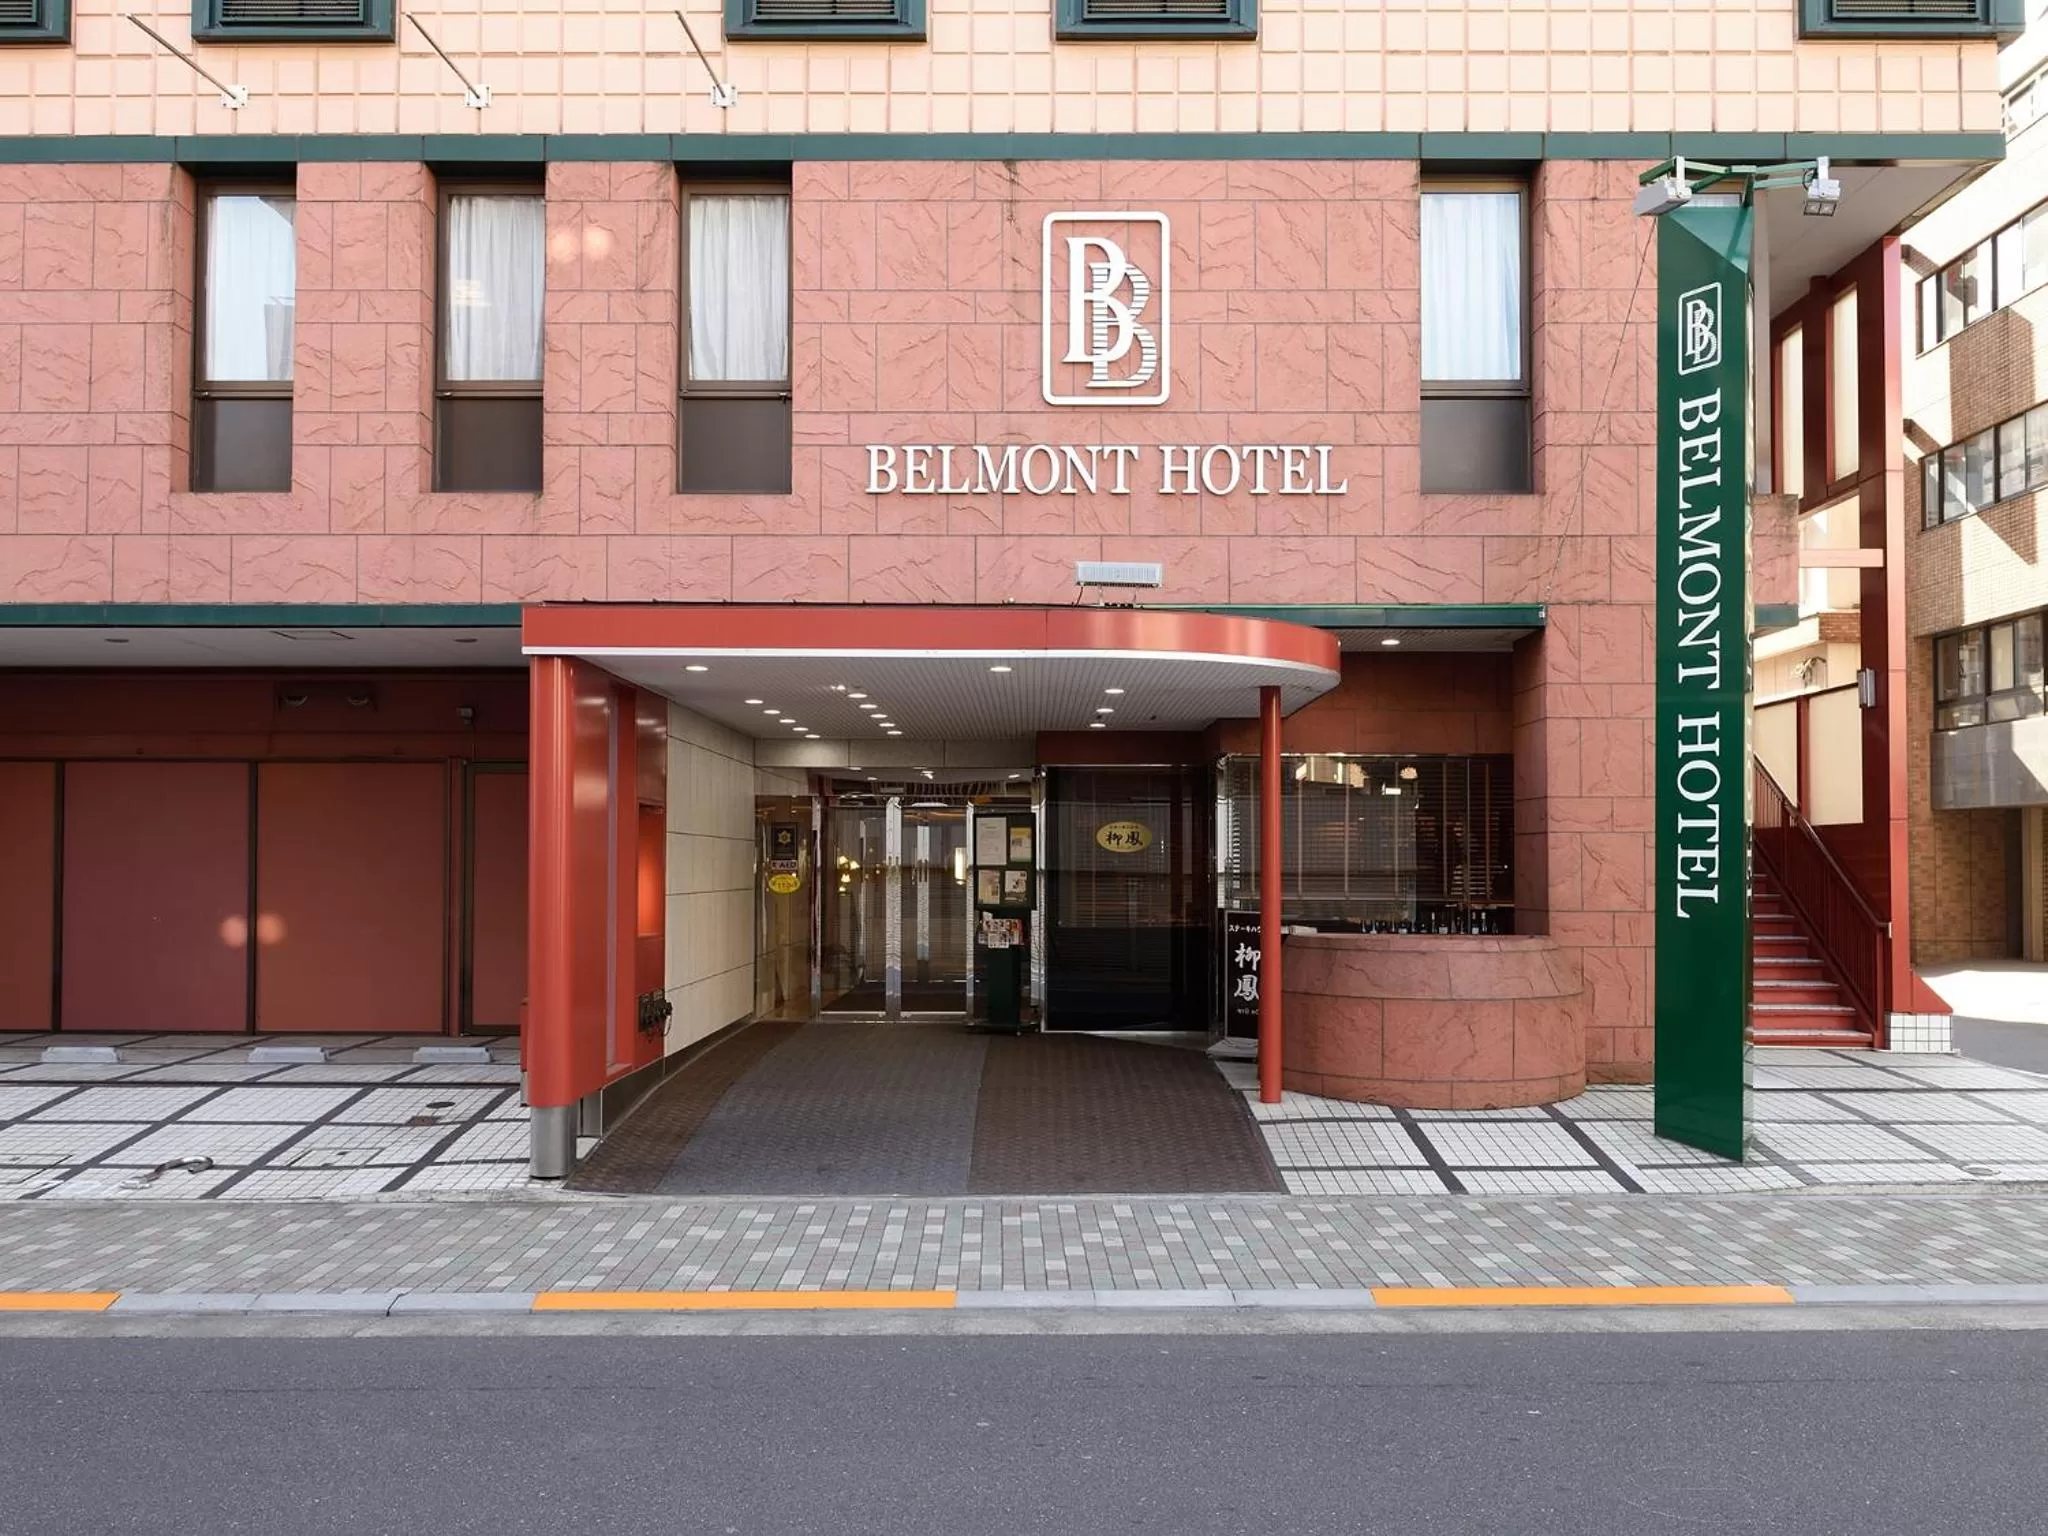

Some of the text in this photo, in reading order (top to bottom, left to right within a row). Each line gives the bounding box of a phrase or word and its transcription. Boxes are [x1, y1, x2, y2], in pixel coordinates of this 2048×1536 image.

[864, 443, 1348, 496] BELMONT HOTEL
[1676, 387, 1722, 919] BELMONT HOTEL
